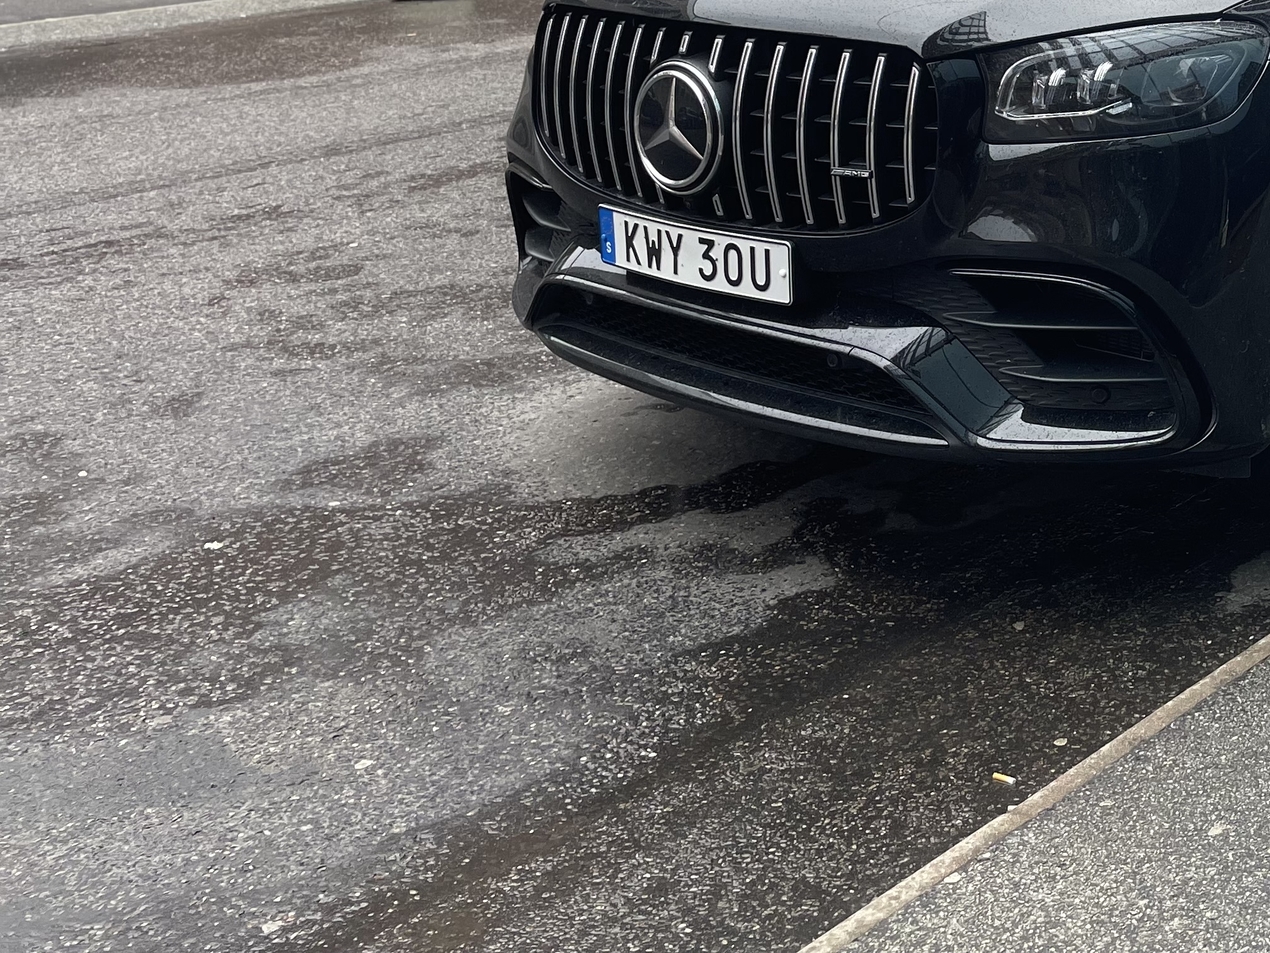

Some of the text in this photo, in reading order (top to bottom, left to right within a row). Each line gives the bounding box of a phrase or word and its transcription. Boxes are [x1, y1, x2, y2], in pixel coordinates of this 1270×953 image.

[605, 242, 612, 253] S
[623, 220, 771, 292] KWY 30U
